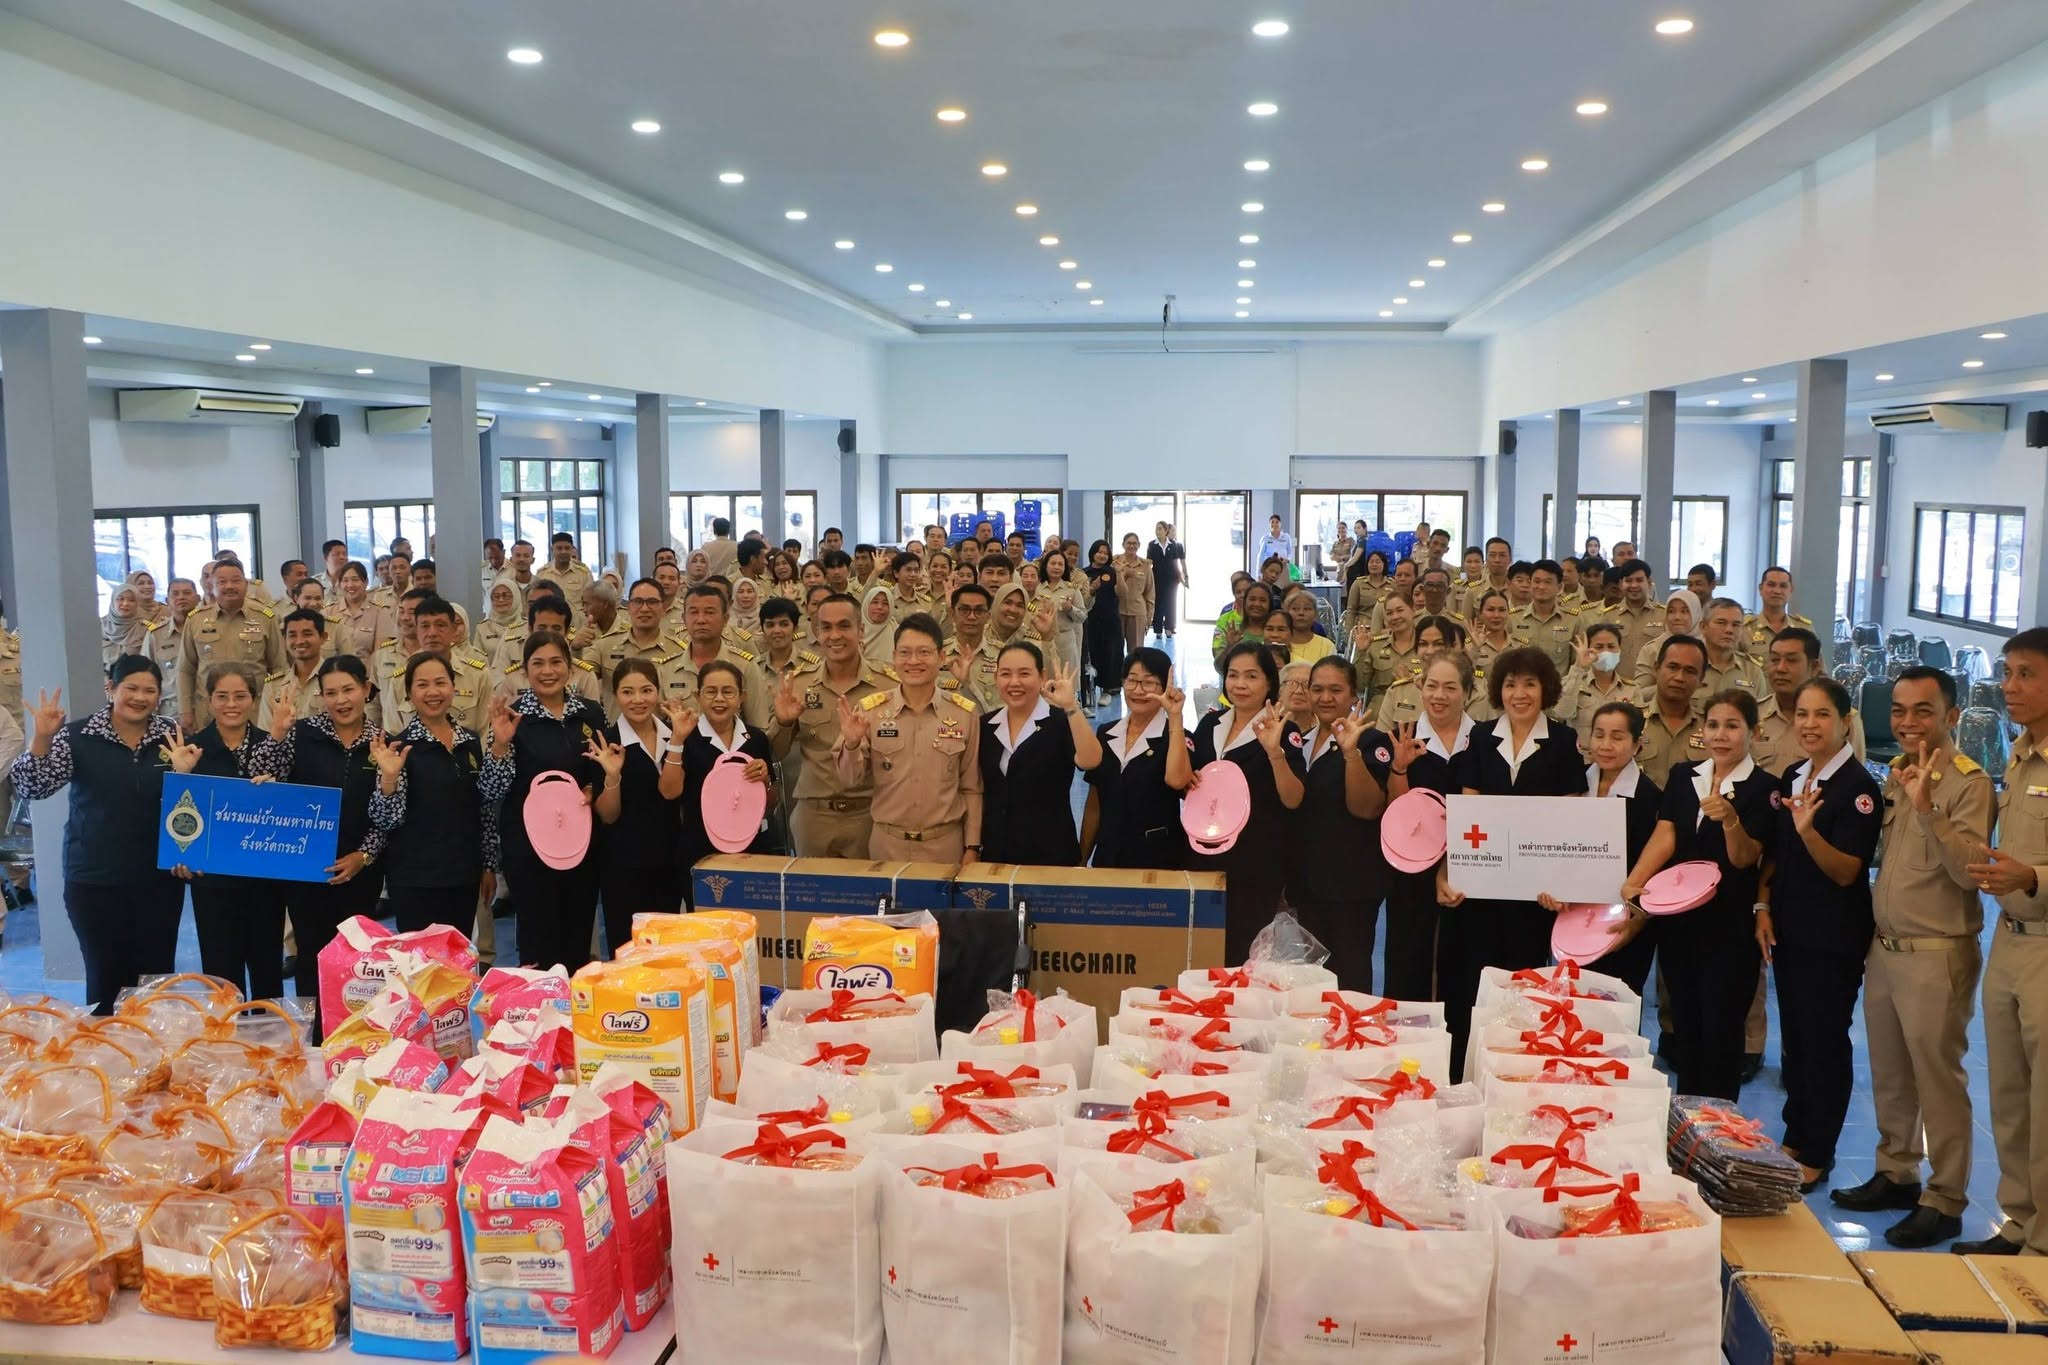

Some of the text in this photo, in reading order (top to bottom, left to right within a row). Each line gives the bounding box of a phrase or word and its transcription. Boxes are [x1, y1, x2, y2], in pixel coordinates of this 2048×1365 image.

[215, 801, 335, 831] ชมรมแม่บ้านมหาดไทย
[1449, 852, 1503, 862] สภากาชาดไทย
[608, 1014, 642, 1029] ไลฟ์รี่
